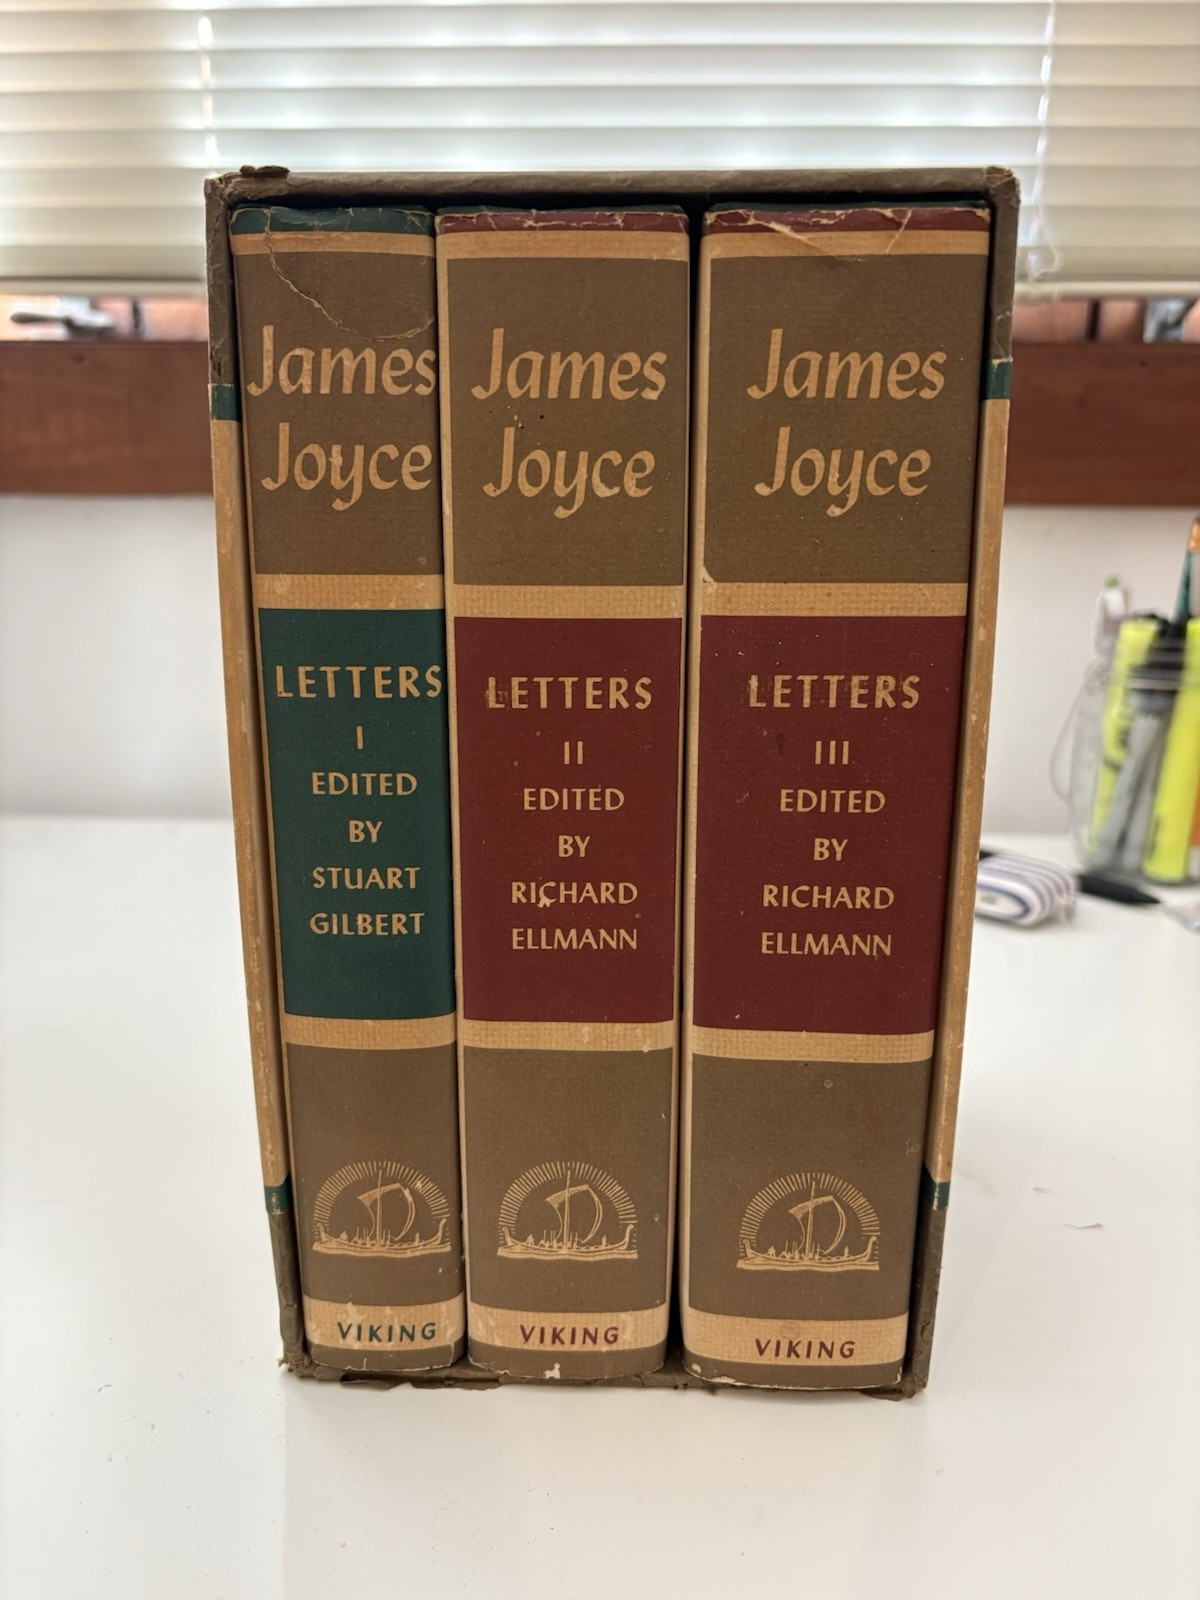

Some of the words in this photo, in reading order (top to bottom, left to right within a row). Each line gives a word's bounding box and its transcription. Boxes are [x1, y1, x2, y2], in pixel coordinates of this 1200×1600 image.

[246, 324, 438, 397] James
[470, 327, 668, 401] James
[746, 328, 947, 400] James
[260, 422, 433, 511] Joyce
[482, 426, 656, 519] Joyce
[753, 426, 931, 518] Joyce
[275, 664, 442, 699] LETTERS
[485, 676, 652, 710] LETTERS
[748, 674, 920, 710] LETTERS
[356, 725, 364, 750] I
[563, 740, 584, 765] II
[814, 740, 850, 765] III
[311, 771, 418, 796] EDITED
[523, 787, 625, 811] EDITED
[779, 788, 886, 814] EDITED
[349, 819, 383, 843] BY
[558, 834, 591, 858] BY
[813, 837, 849, 862] BY
[312, 866, 421, 890] STUART
[511, 881, 638, 907] RICHARD
[762, 884, 895, 910] RICHARD
[309, 912, 425, 936] GILBERT
[512, 927, 637, 950] ELLMANN
[761, 931, 892, 957] ELLMANN
[337, 1321, 437, 1343] VIKING
[519, 1324, 619, 1346] VIKING
[754, 1338, 856, 1360] VIKING
